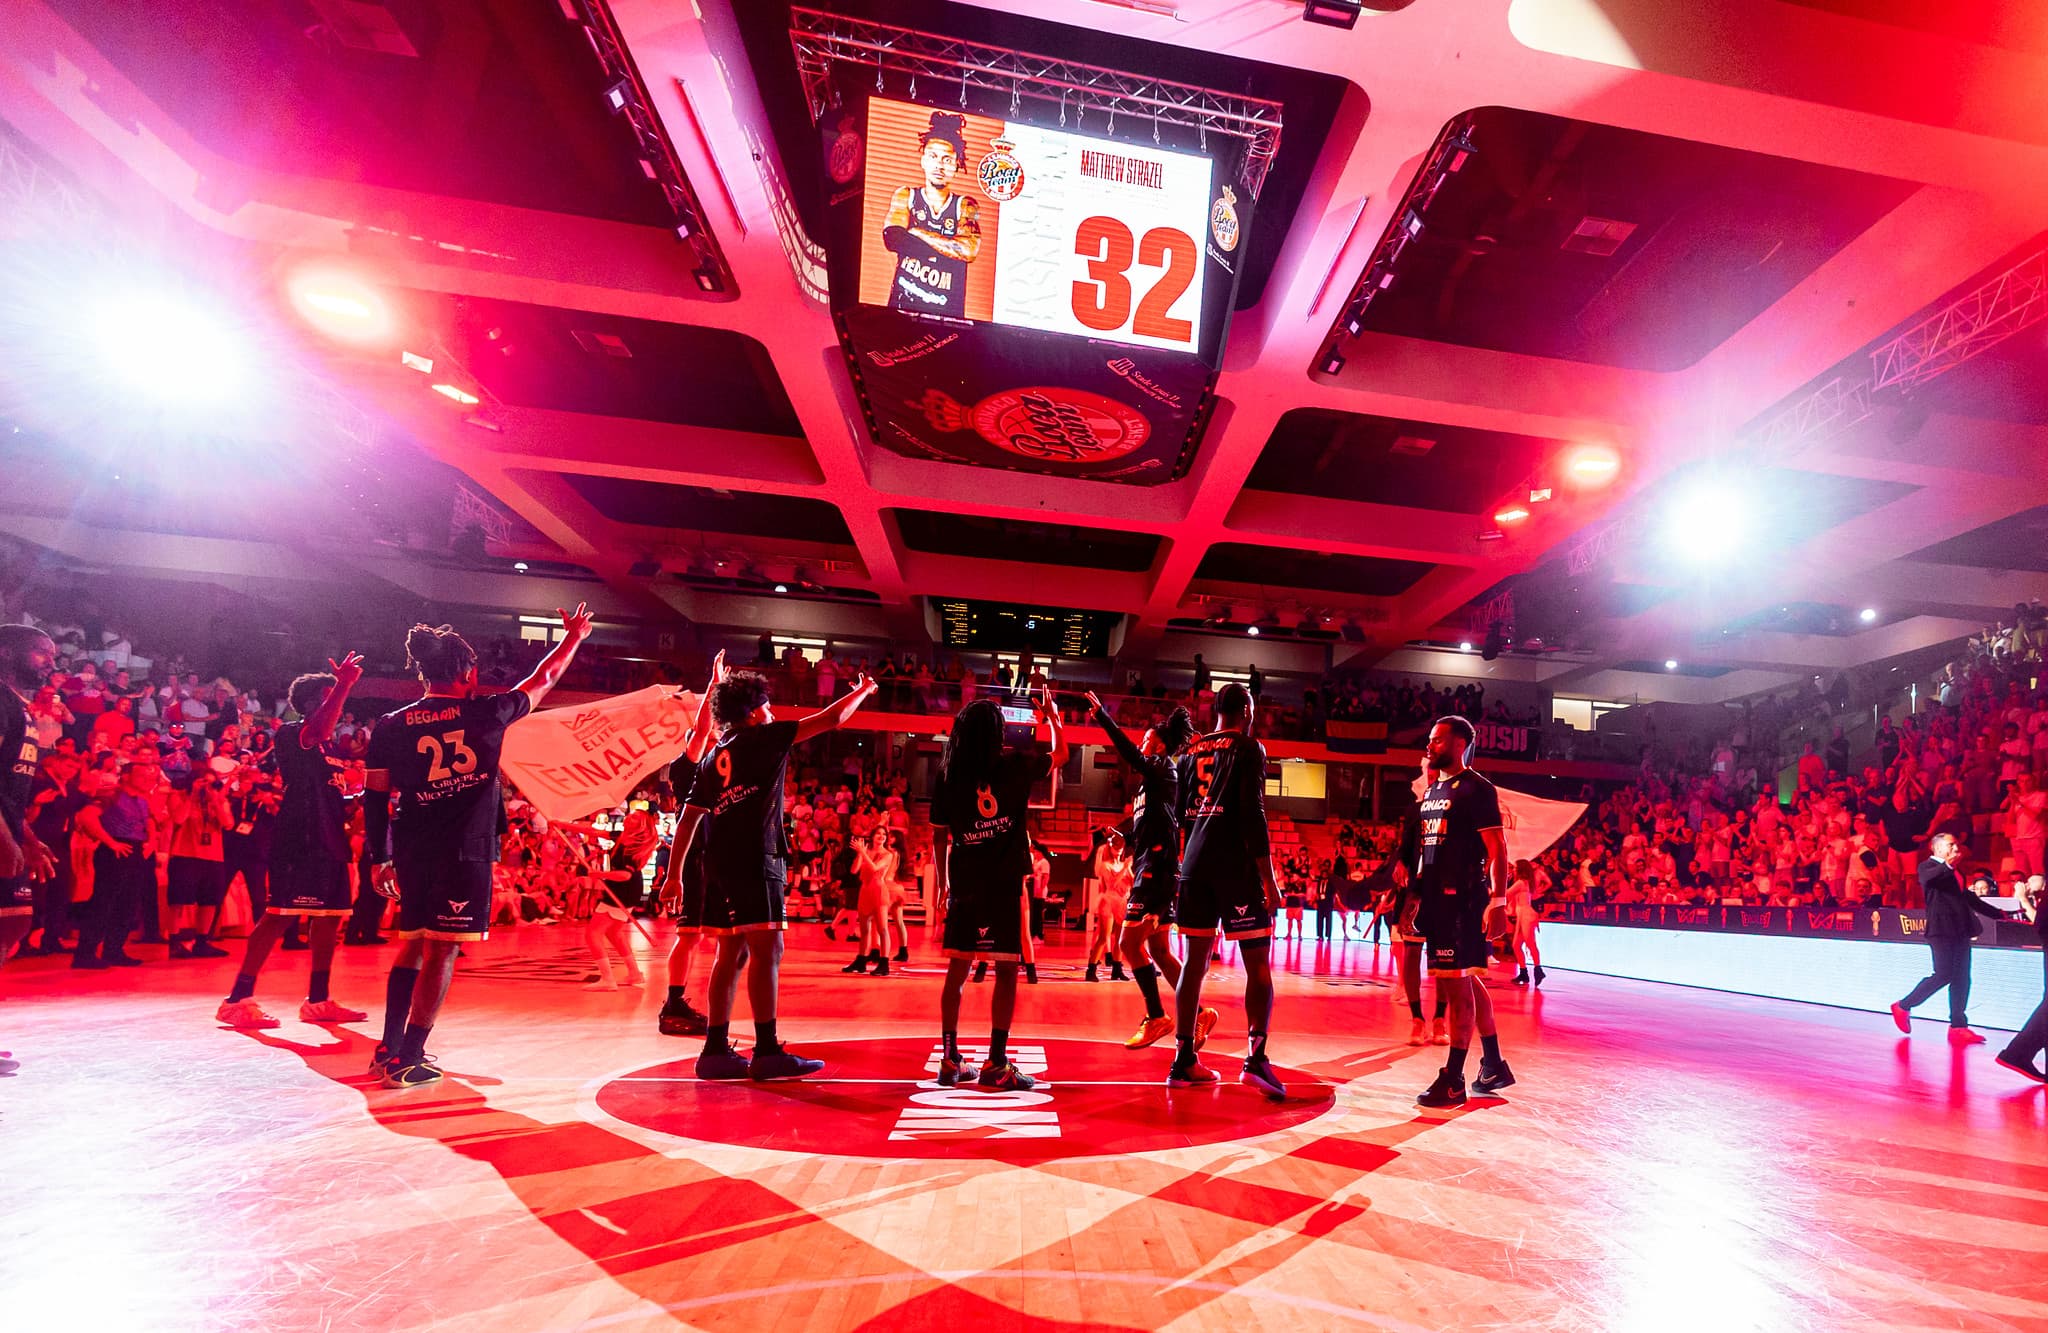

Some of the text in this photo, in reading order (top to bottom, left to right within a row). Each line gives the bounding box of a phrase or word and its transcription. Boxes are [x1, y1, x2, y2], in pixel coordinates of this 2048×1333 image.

[1081, 150, 1163, 189] MATTHEW STRAZEL
[1071, 215, 1198, 343] 32
[417, 729, 478, 782] 23
[538, 707, 683, 790] FINALES
[581, 722, 619, 752] ELITE
[716, 749, 732, 788] 9
[1197, 756, 1215, 797] 5
